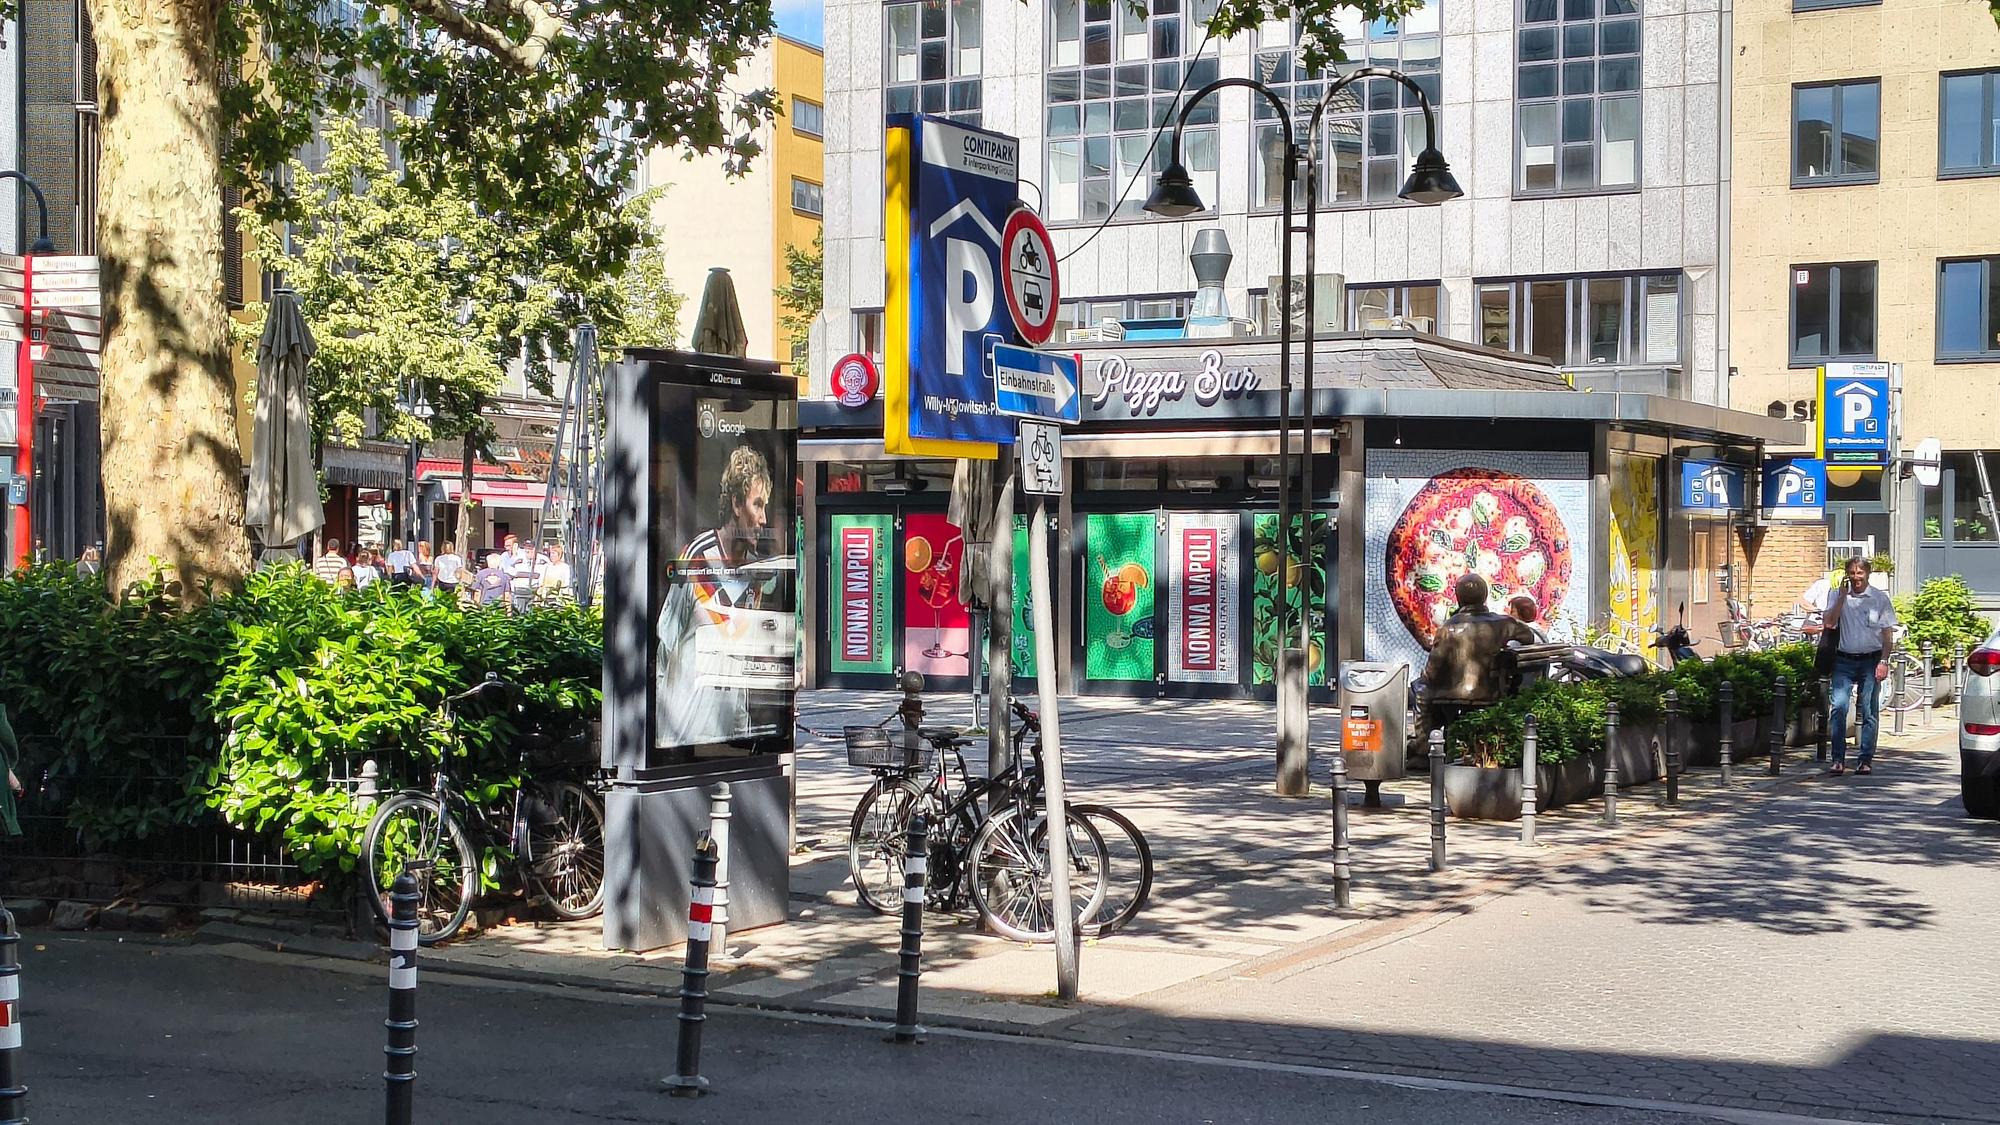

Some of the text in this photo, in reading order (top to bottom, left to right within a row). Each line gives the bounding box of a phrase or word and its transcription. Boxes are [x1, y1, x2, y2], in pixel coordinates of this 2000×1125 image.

[964, 135, 1014, 162] CONTIPARK
[946, 237, 994, 376] P
[1000, 371, 1056, 395] Einbahnstraße
[1092, 349, 1260, 410] Pizza Bar
[718, 419, 746, 437] Google
[1843, 393, 1872, 433] P
[1777, 473, 1802, 504] P
[846, 533, 870, 656] NONNA NAPOLI
[876, 527, 884, 662] NEAPOLITAN PIZZA BAR
[1188, 534, 1212, 665] NONNA NAPOLI
[1219, 528, 1228, 671] NEAPOLITAN PIZZA BAR
